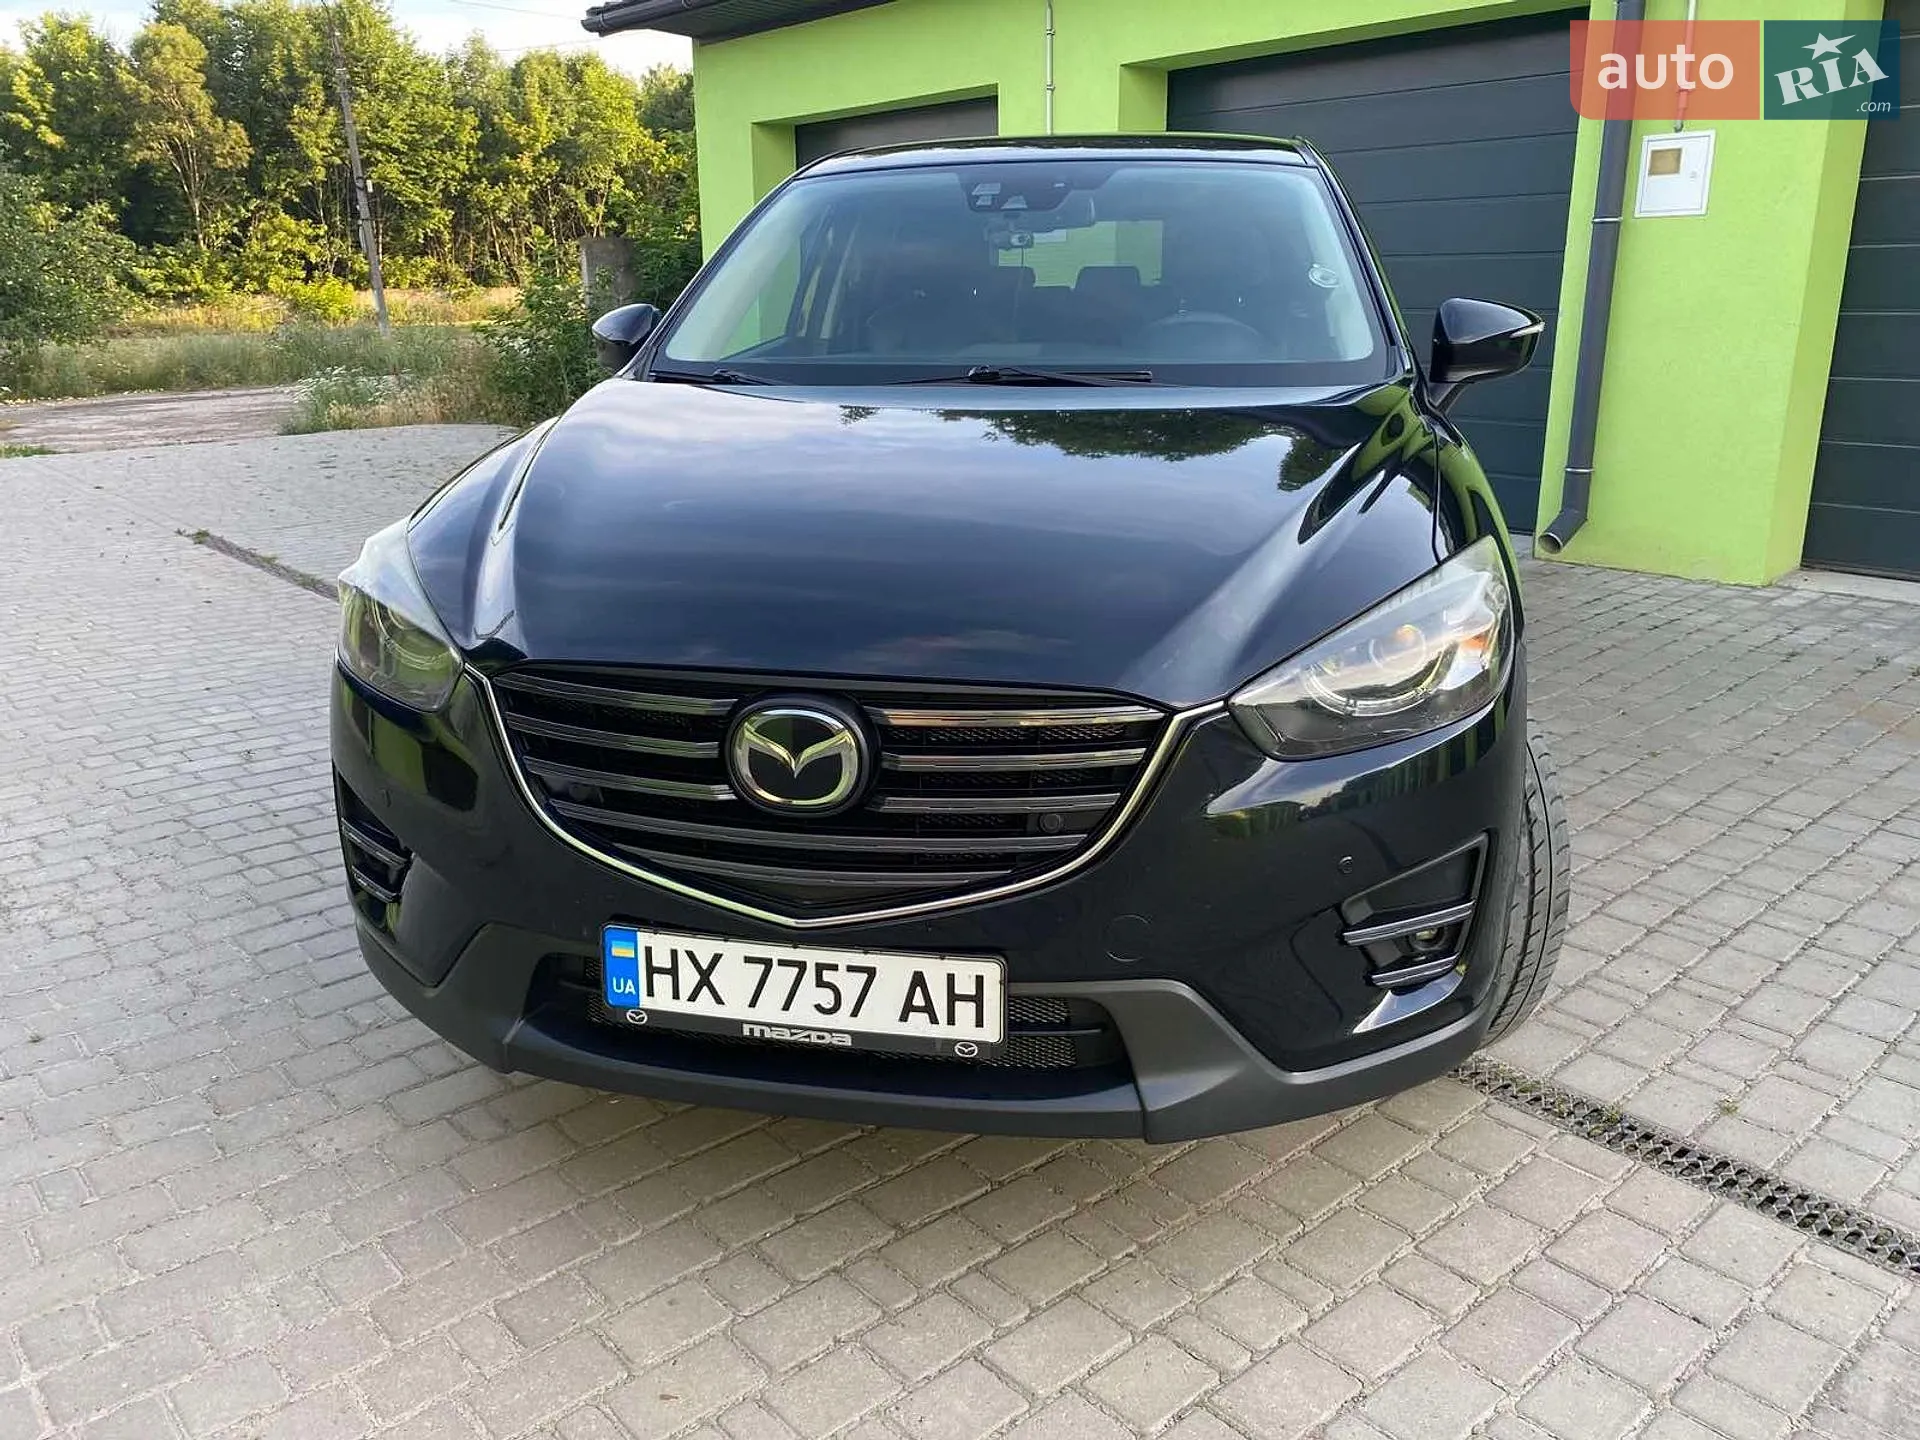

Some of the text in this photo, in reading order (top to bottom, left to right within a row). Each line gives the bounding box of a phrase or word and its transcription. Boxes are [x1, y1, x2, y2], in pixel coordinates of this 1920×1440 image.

[612, 976, 637, 995] UA
[644, 945, 985, 1028] HX 7757 AH
